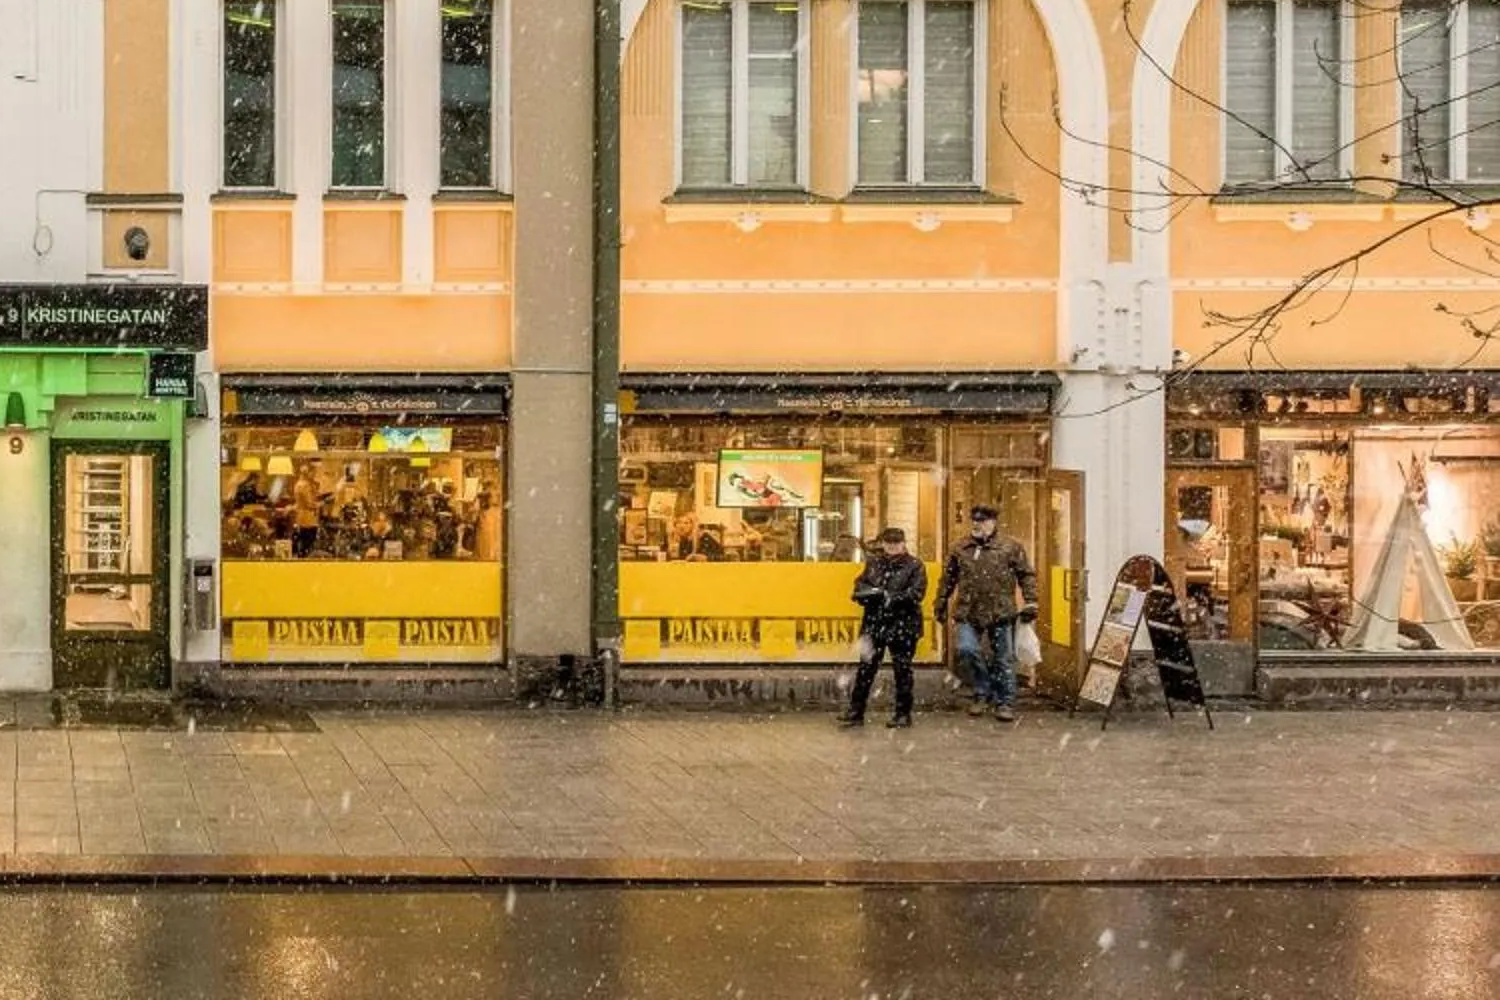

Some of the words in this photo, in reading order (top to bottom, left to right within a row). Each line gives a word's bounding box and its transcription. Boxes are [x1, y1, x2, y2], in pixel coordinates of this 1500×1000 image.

[7, 309, 18, 323] 9
[27, 308, 166, 324] KRISTINEGATAN
[9, 436, 24, 454] 9
